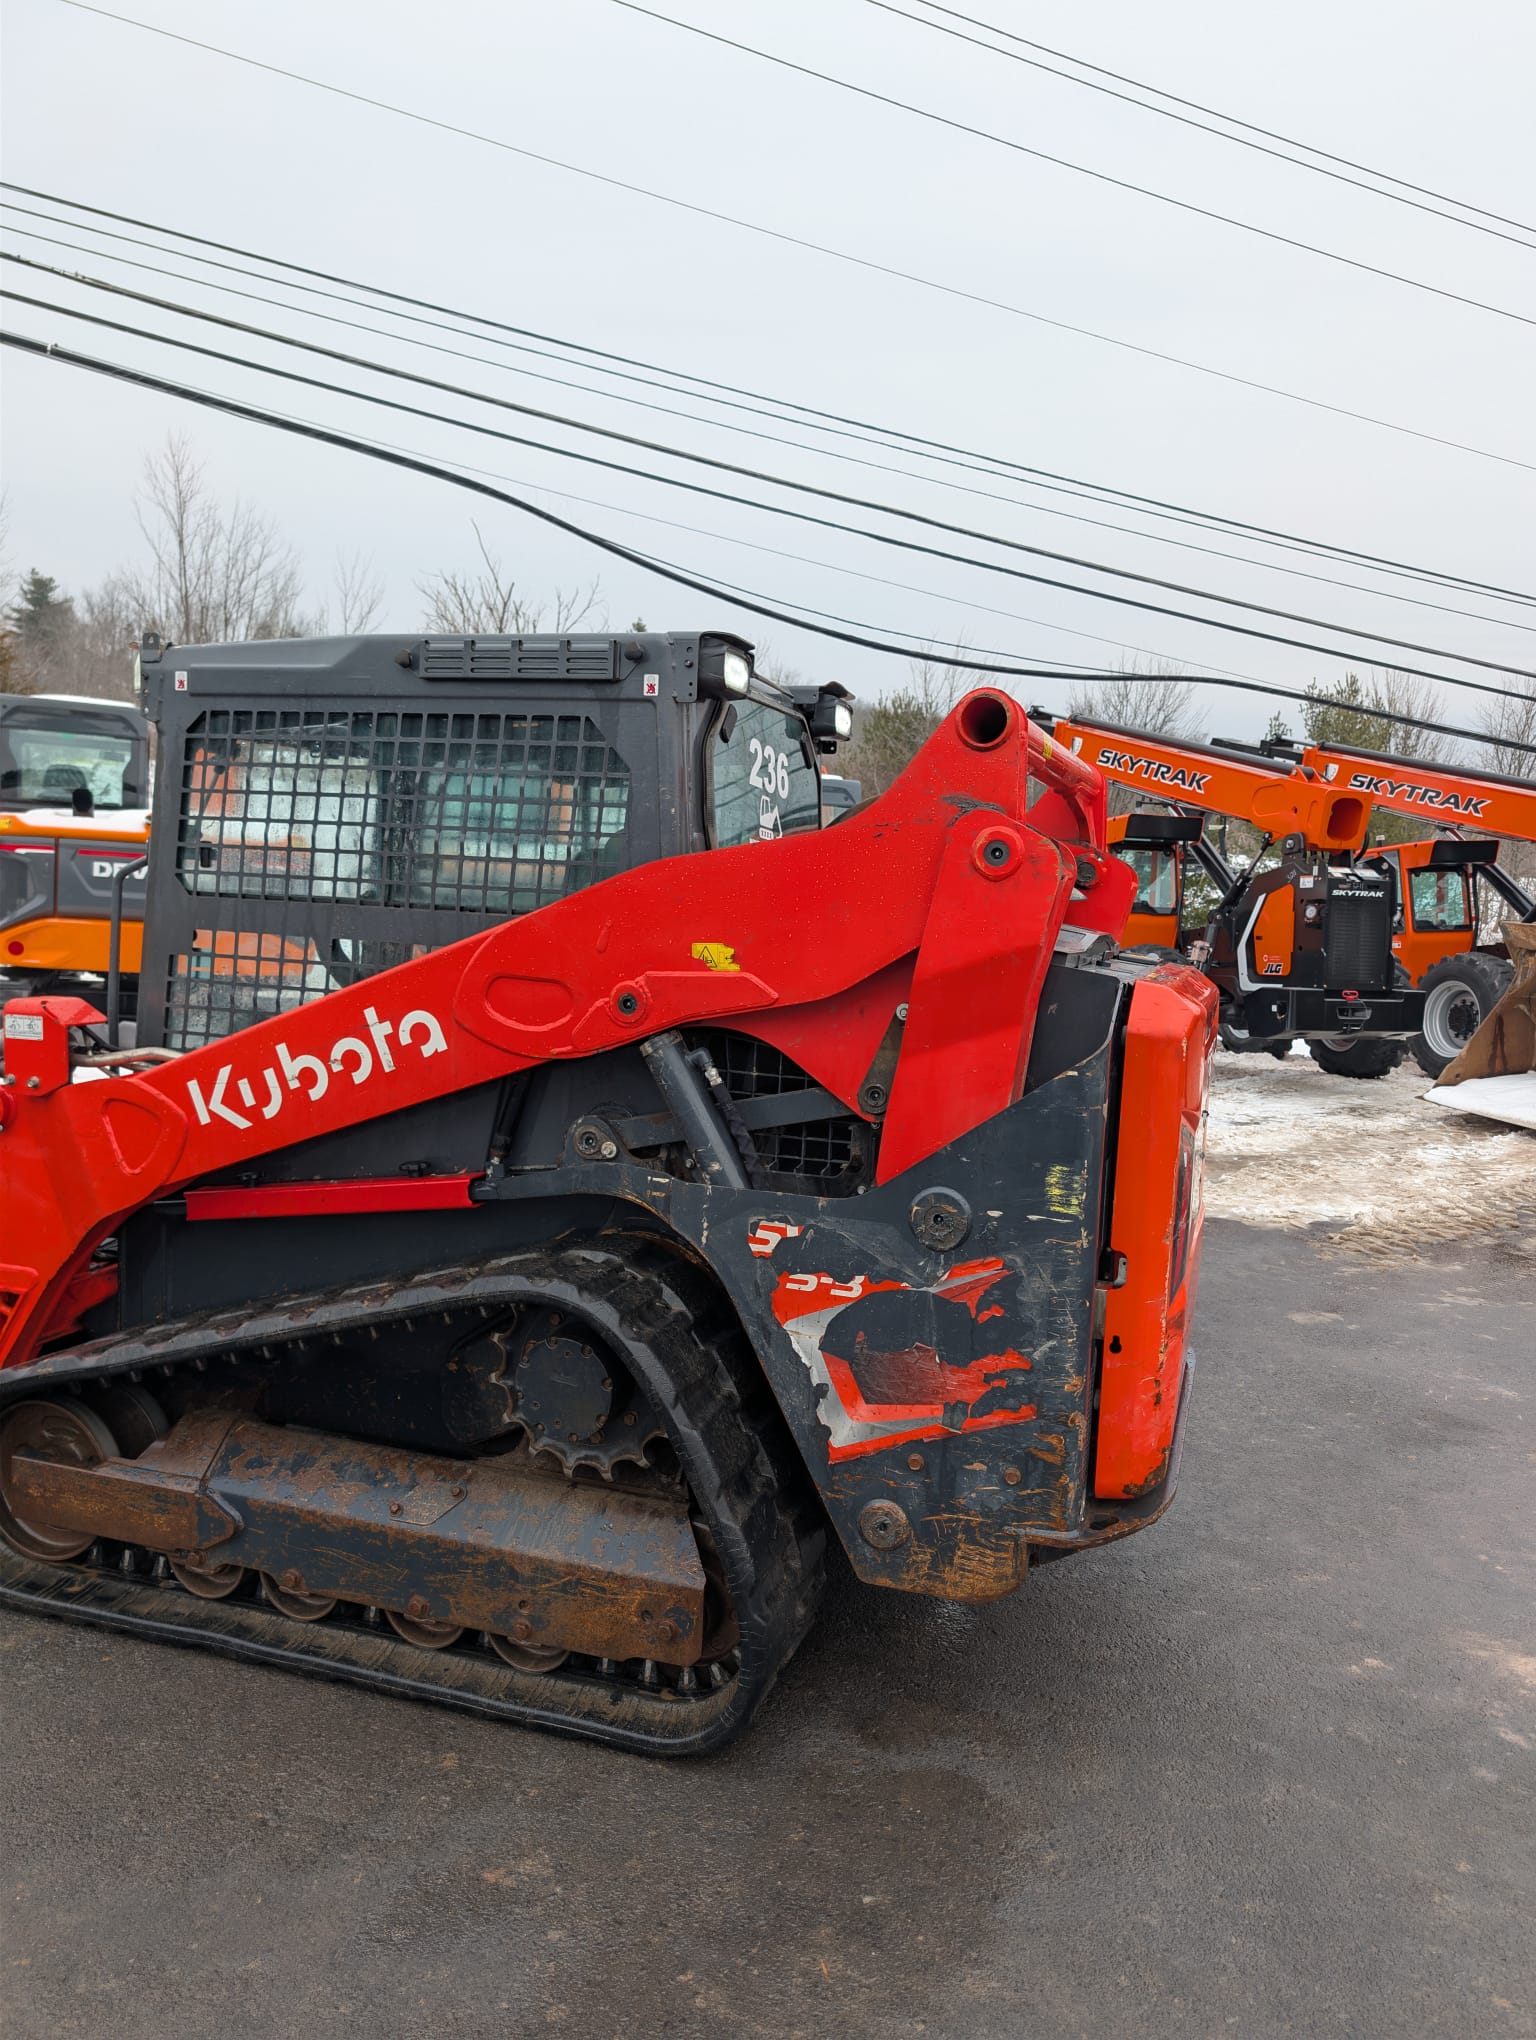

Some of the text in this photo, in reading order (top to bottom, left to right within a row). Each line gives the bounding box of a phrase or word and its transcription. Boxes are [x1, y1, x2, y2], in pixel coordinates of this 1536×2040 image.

[749, 738, 789, 799] 236
[1096, 748, 1212, 794] SKYTRAK
[1347, 773, 1492, 817] SKYTRAK
[1331, 889, 1385, 898] SKYTRAK
[1263, 962, 1283, 976] JLG
[186, 1006, 448, 1130] Kubota
